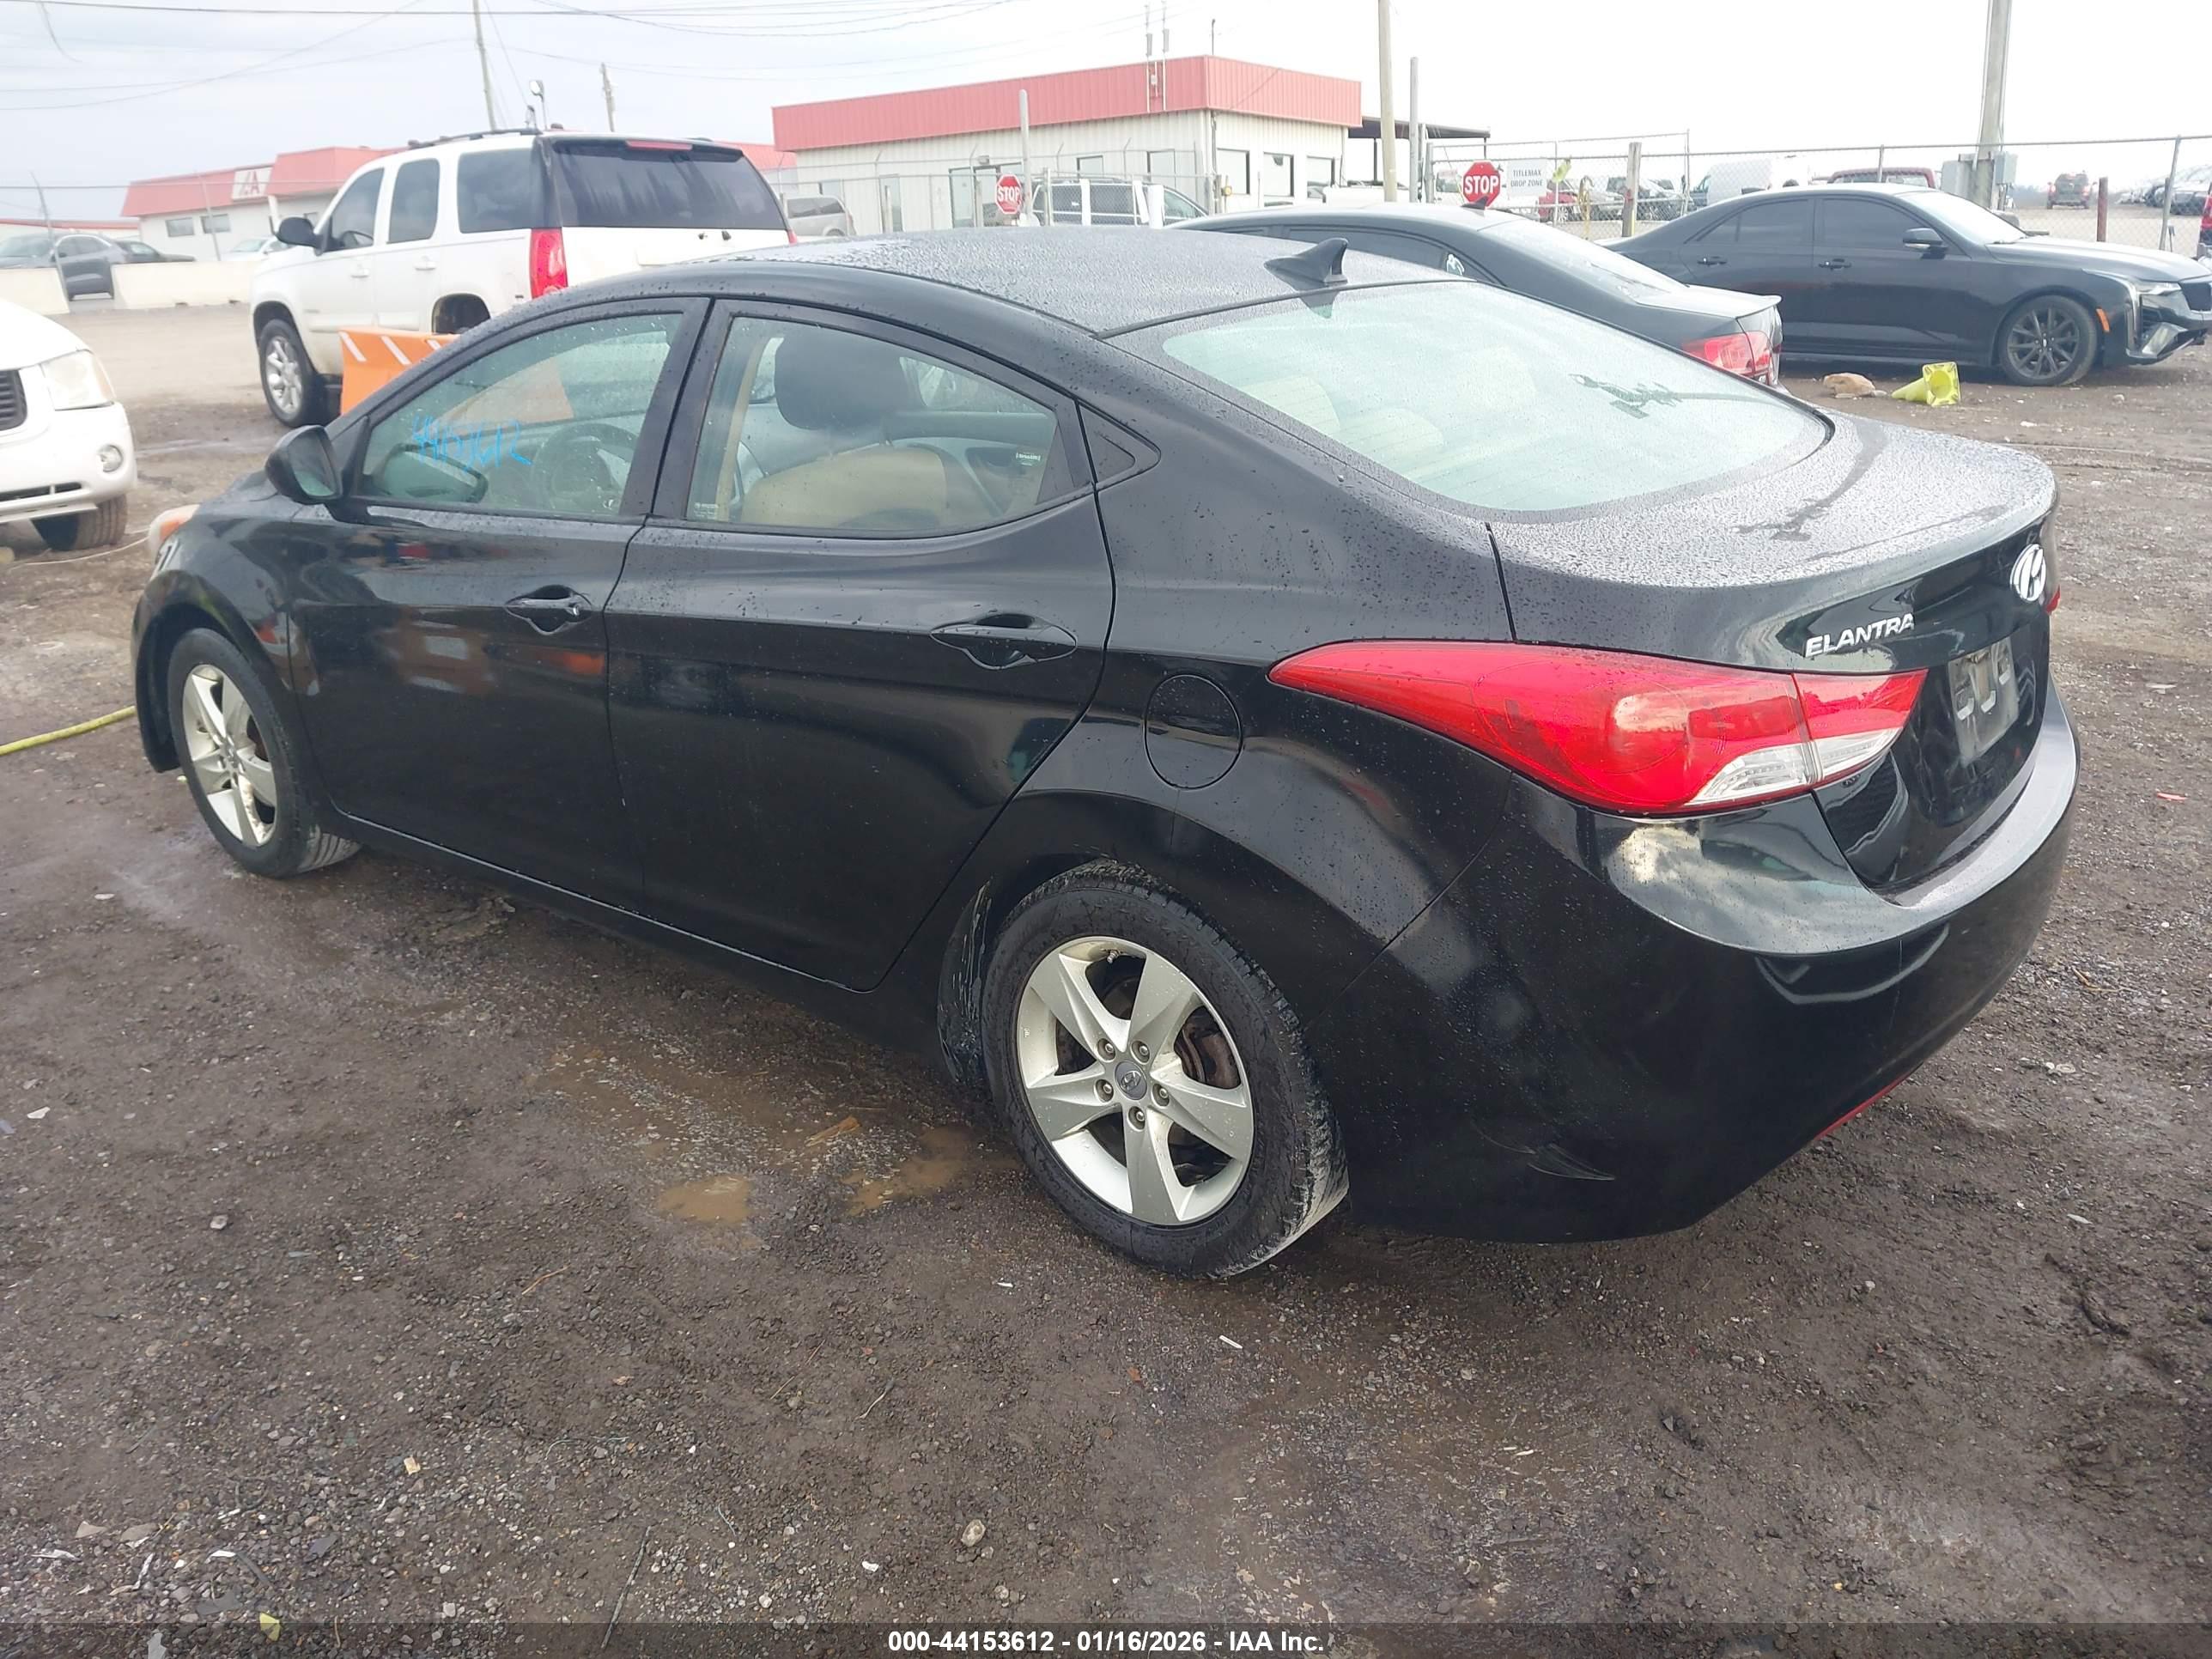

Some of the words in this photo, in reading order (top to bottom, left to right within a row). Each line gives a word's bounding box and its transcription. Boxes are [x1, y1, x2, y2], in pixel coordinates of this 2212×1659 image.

[1464, 175, 1499, 194] STOP
[1528, 179, 1543, 187] ZONE
[998, 185, 1020, 203] STOP
[1805, 612, 1914, 658] ELANTRA
